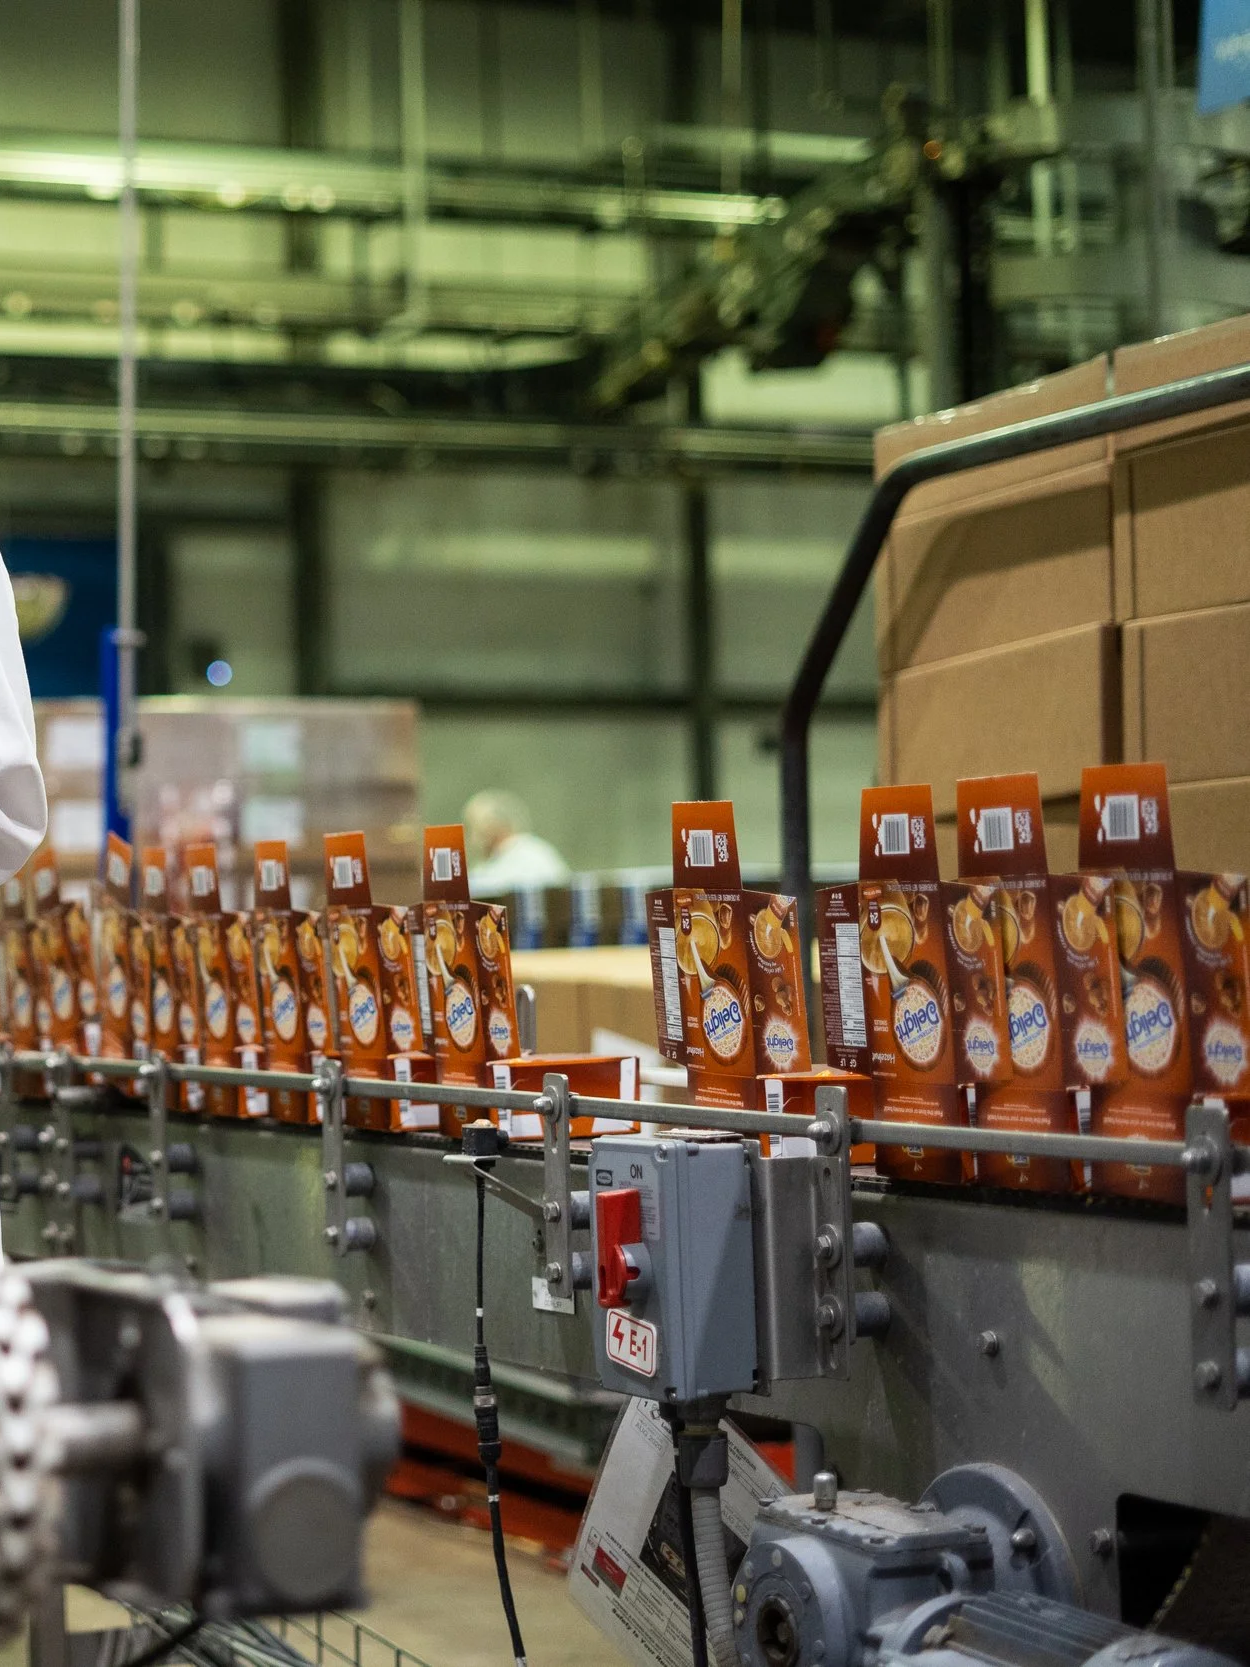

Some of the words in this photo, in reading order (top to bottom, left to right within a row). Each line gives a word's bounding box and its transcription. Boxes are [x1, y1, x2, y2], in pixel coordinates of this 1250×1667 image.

[682, 919, 690, 929] 24
[870, 913, 879, 925] 24
[704, 1002, 742, 1038] Delight
[895, 1001, 940, 1043] Delight
[1127, 1002, 1172, 1043] Deligh
[765, 1034, 794, 1051] Delight
[966, 1036, 995, 1054] Delight
[1077, 1038, 1108, 1057] Delight
[687, 1046, 705, 1058] Hazelnut
[872, 1052, 896, 1064] Hazelnut
[840, 1058, 846, 1067] LF
[849, 1058, 857, 1068] GF
[934, 1110, 943, 1118] Feel
[630, 1164, 642, 1179] ON
[630, 1329, 647, 1361] E-1
[605, 1531, 622, 1549] ALWAYS
[622, 1548, 641, 1569] PERFORM
[644, 1571, 662, 1591] MACHINE
[662, 1590, 673, 1601] STOP
[673, 1601, 689, 1619] BEFORE
[612, 1607, 631, 1630] Safety
[632, 1630, 639, 1638] Is
[641, 1639, 655, 1655] Your
